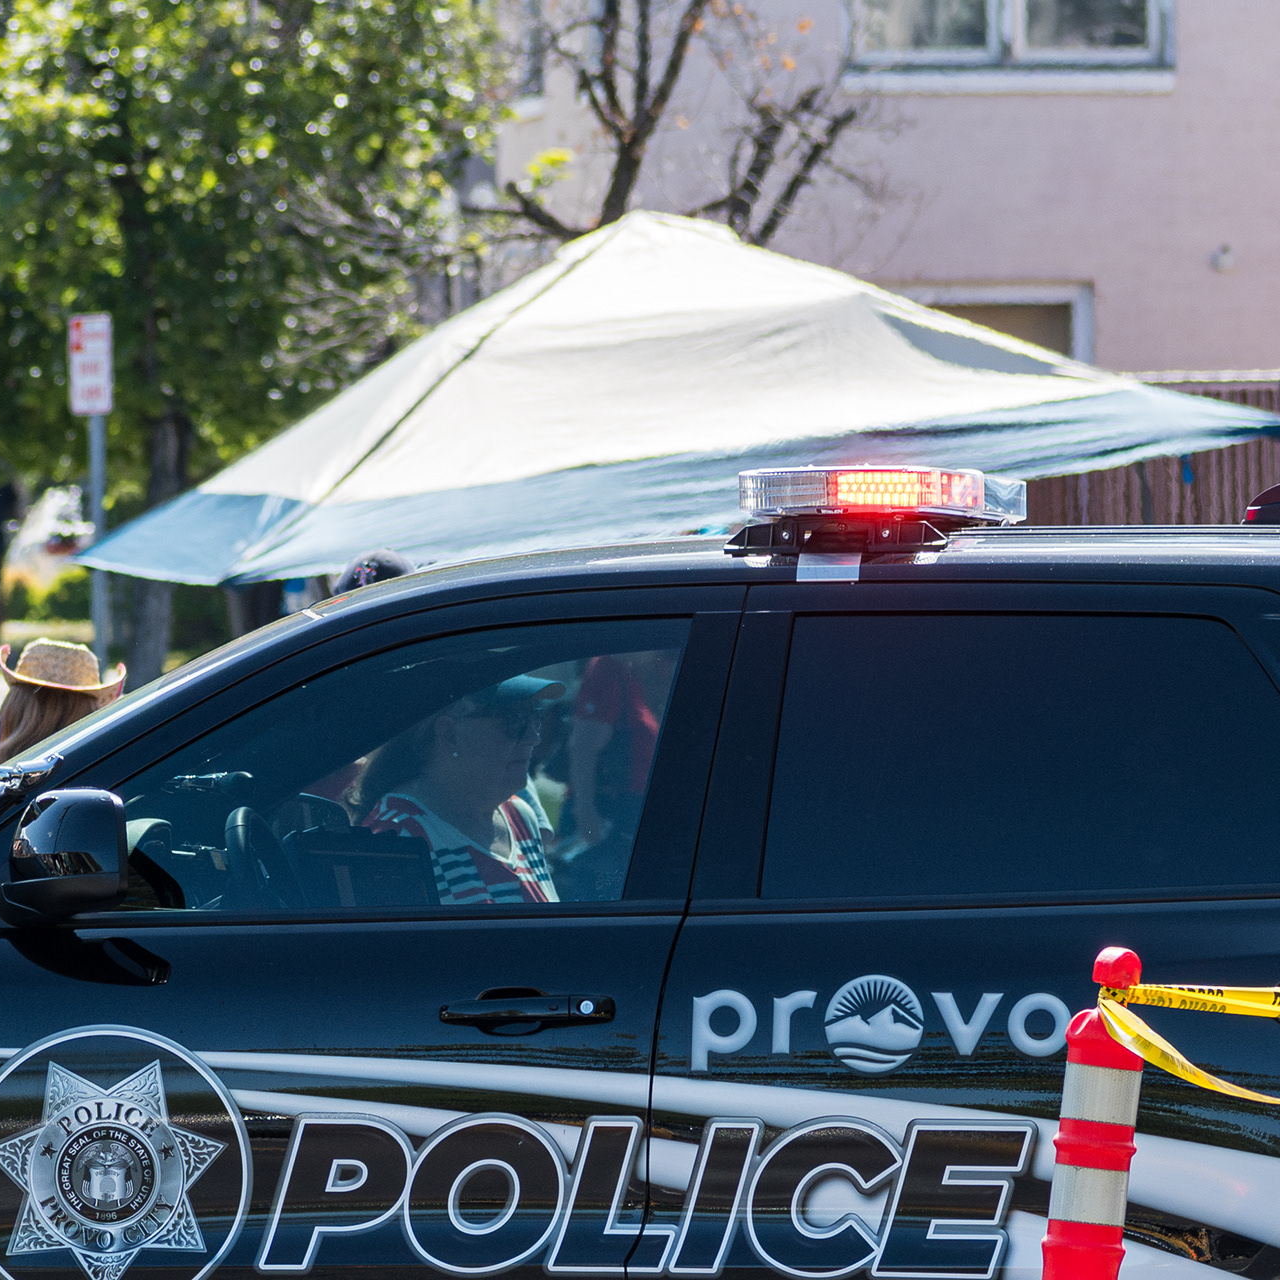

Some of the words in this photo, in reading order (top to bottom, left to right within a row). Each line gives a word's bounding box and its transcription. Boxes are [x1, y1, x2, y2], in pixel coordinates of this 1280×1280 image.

[57, 1101, 161, 1139] POLICE
[68, 1135, 92, 1156] SEAL
[93, 1130, 107, 1139] OF
[108, 1130, 128, 1143] THE
[128, 1138, 151, 1167] STATE
[61, 1156, 73, 1191] GREAT
[143, 1169, 152, 1184] OF
[66, 1188, 83, 1211] THE
[130, 1185, 150, 1210] UTAH
[40, 1195, 114, 1249] PROVO
[122, 1193, 175, 1245] CITY
[95, 1211, 118, 1221] 1896
